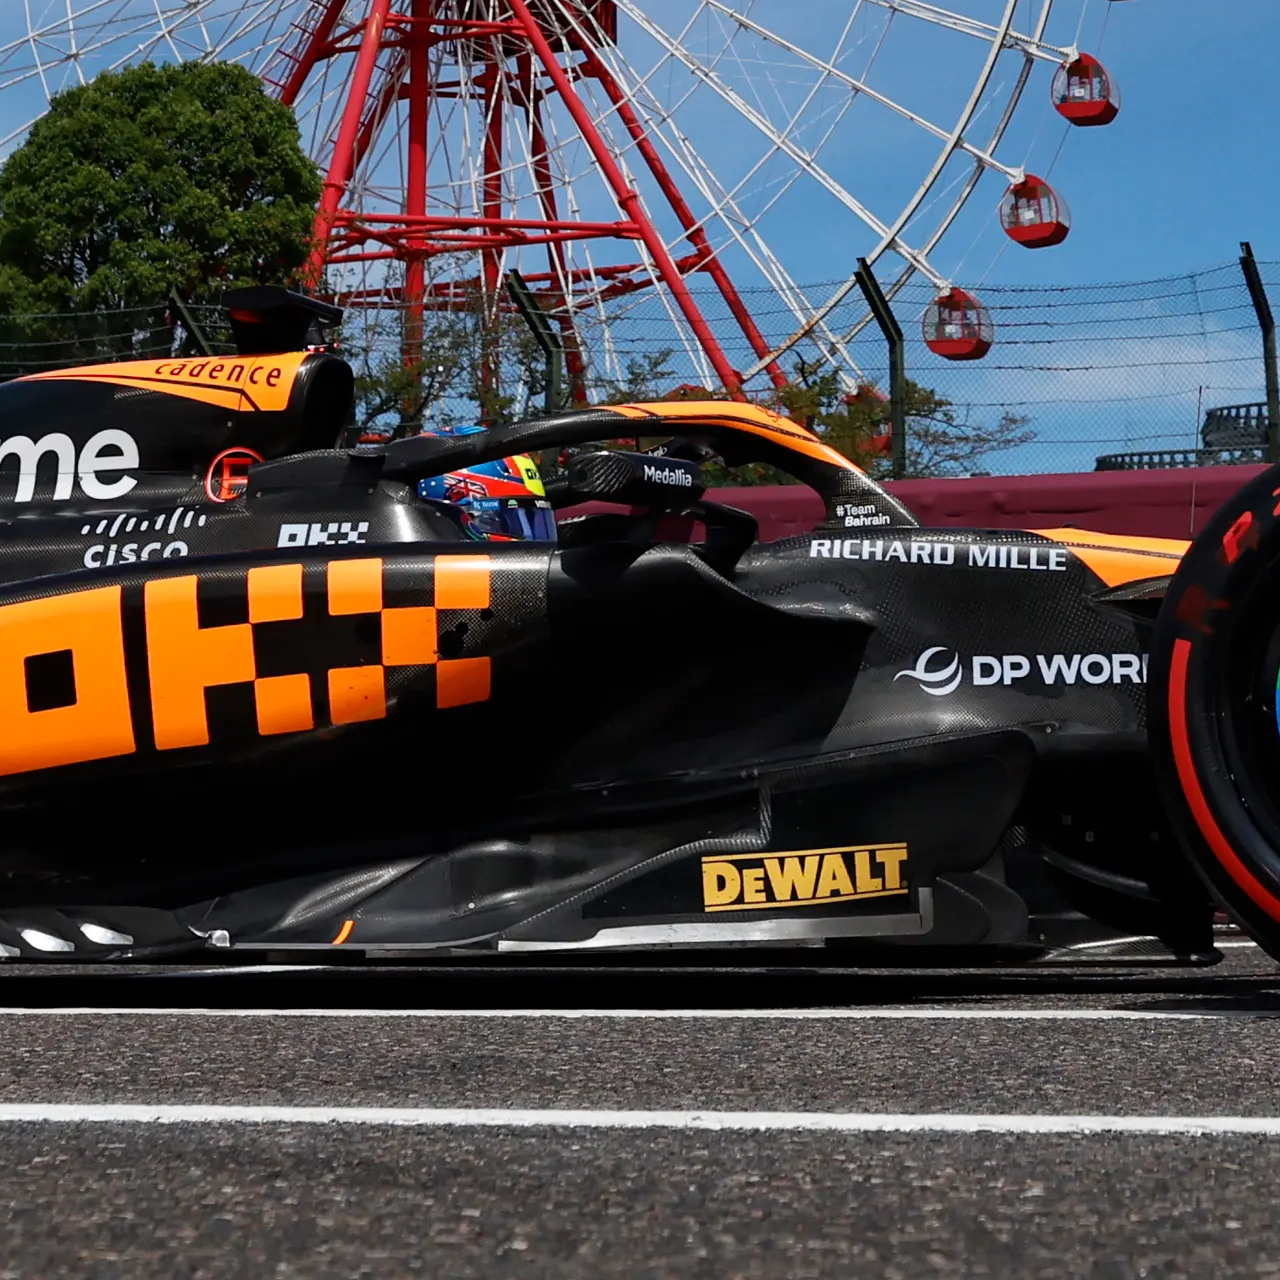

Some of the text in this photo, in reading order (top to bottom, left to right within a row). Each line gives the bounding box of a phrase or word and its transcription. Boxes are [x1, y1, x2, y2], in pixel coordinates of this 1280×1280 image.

[643, 464, 693, 487] Medallia
[836, 504, 875, 517] #Team
[845, 514, 891, 527] Bahrain
[277, 522, 370, 548] OKX
[1223, 510, 1253, 564] P
[809, 539, 1067, 571] RICHARD MILLE
[972, 654, 1030, 686] DP
